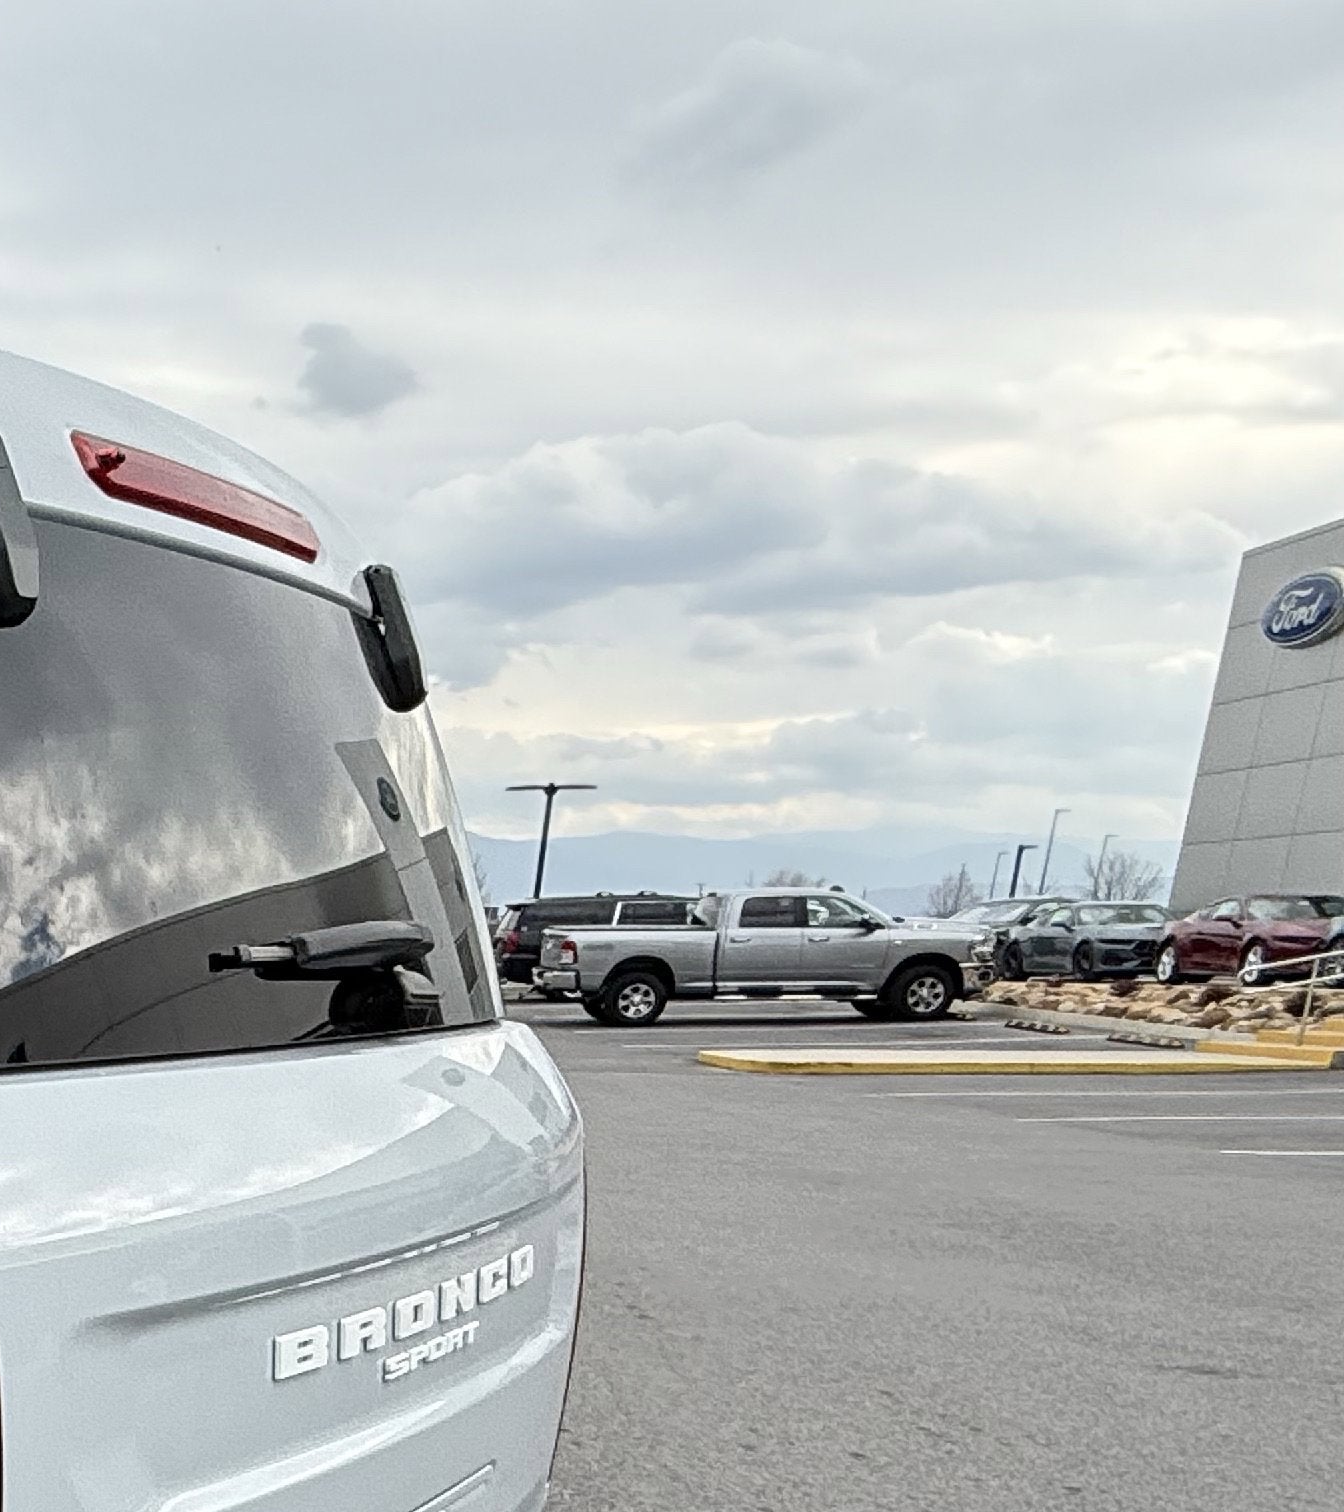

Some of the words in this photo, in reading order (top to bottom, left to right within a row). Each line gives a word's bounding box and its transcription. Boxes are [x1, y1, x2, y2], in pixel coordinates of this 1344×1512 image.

[1272, 586, 1324, 634] Ford
[271, 1244, 534, 1382] BRONCO
[382, 1320, 480, 1382] SPORT
